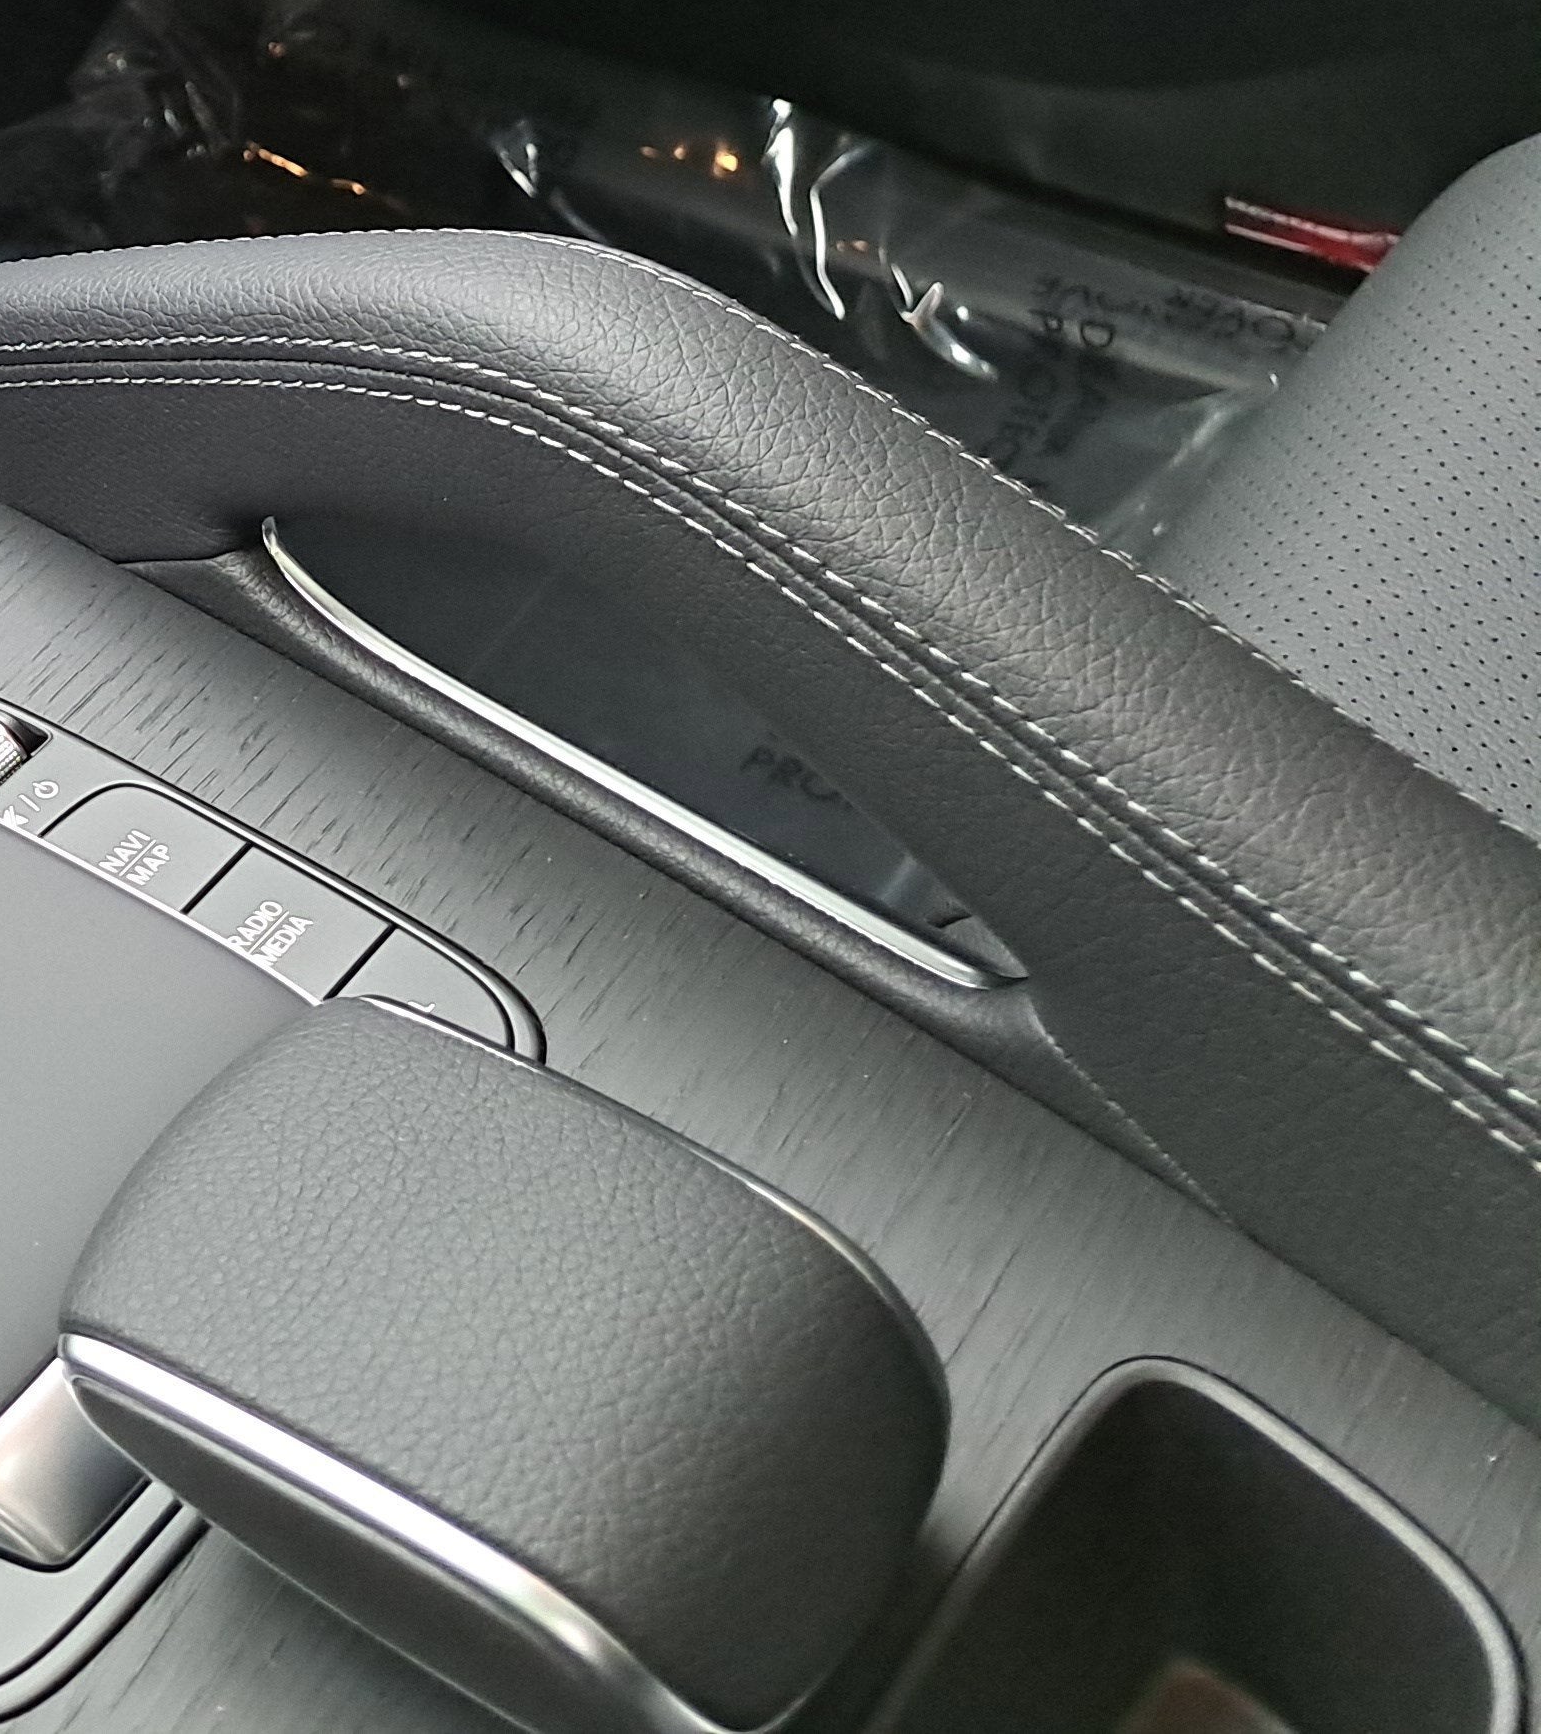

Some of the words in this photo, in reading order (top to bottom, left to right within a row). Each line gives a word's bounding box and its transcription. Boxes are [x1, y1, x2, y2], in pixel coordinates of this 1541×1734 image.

[98, 829, 151, 873] NAVI
[126, 843, 172, 886] MAP
[227, 900, 283, 948] RADIO
[251, 916, 314, 966] MEDIA
